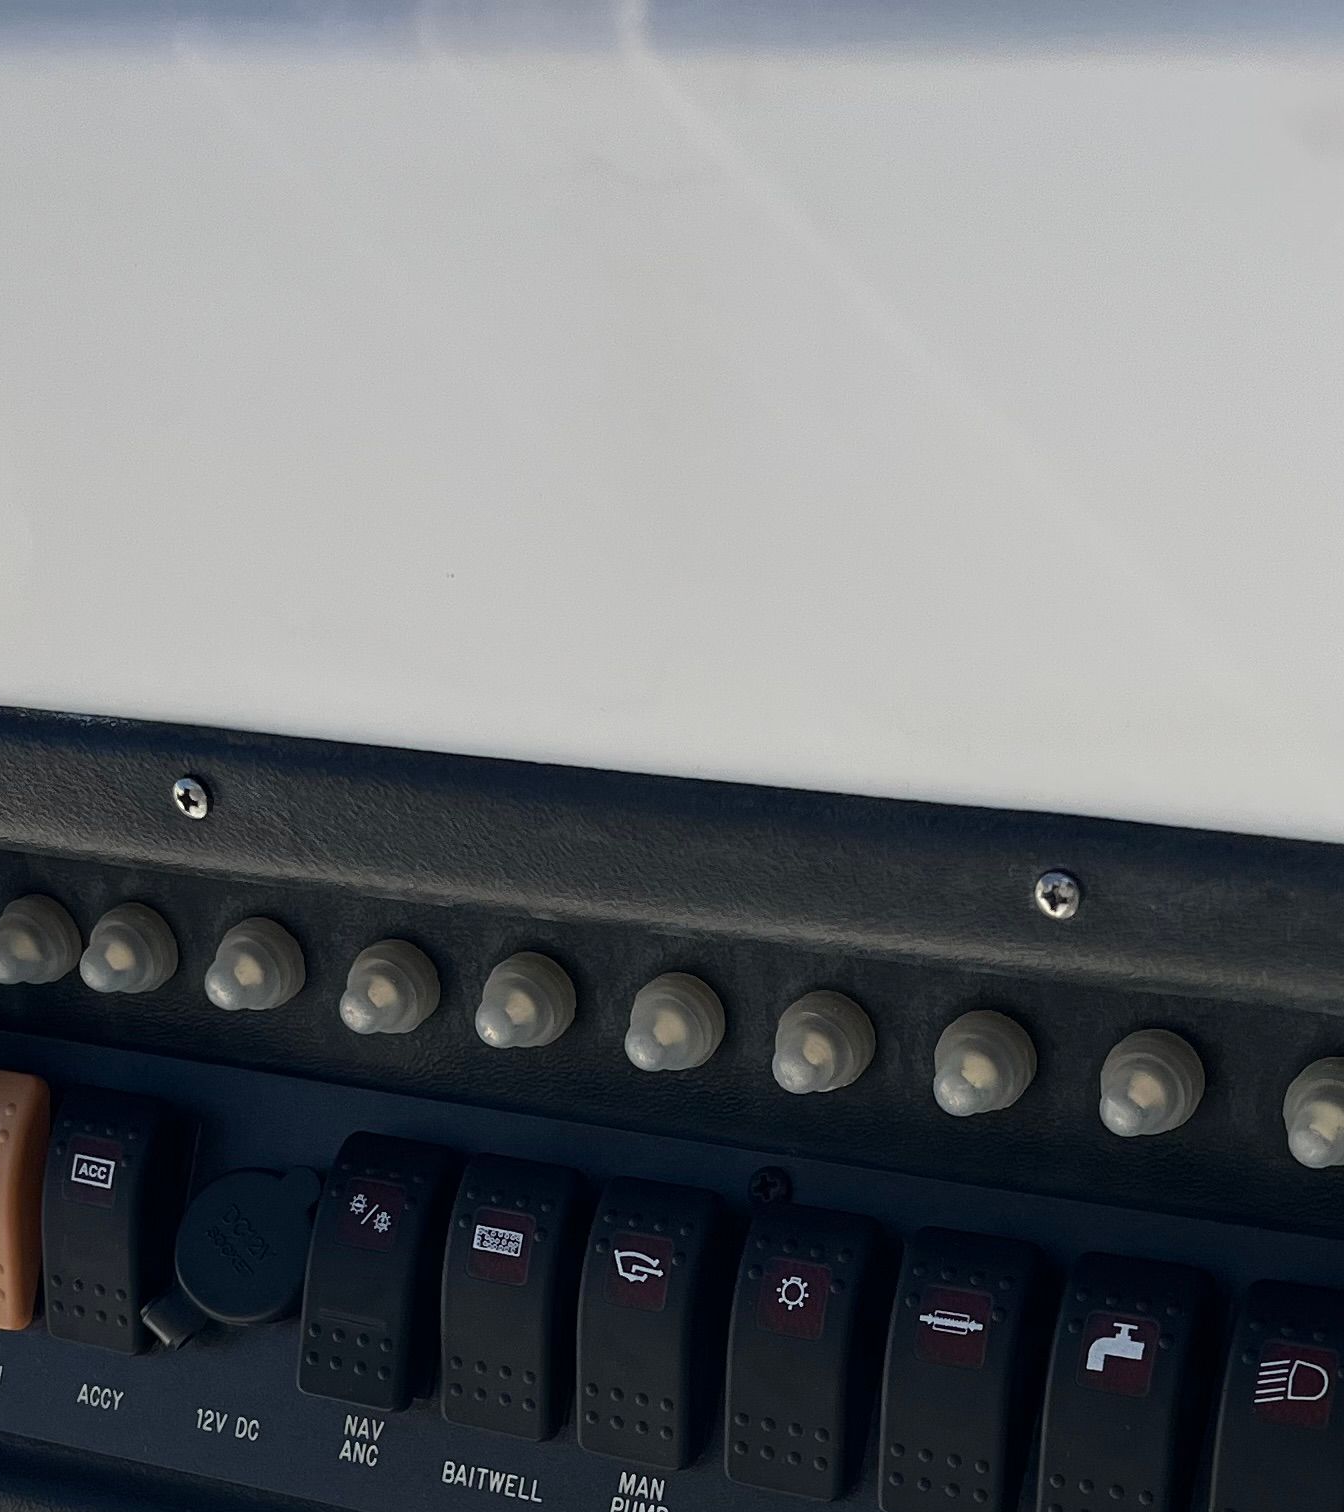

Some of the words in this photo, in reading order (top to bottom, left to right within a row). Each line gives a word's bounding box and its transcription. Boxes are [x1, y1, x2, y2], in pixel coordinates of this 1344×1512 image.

[78, 1162, 107, 1180] ACC
[76, 1383, 124, 1411] ACCY
[196, 1408, 228, 1433] 12V
[235, 1416, 260, 1441] DC
[344, 1415, 385, 1442] NAV
[339, 1440, 379, 1467] ANC
[442, 1460, 543, 1503] BAITWELL
[618, 1471, 665, 1502] MAN
